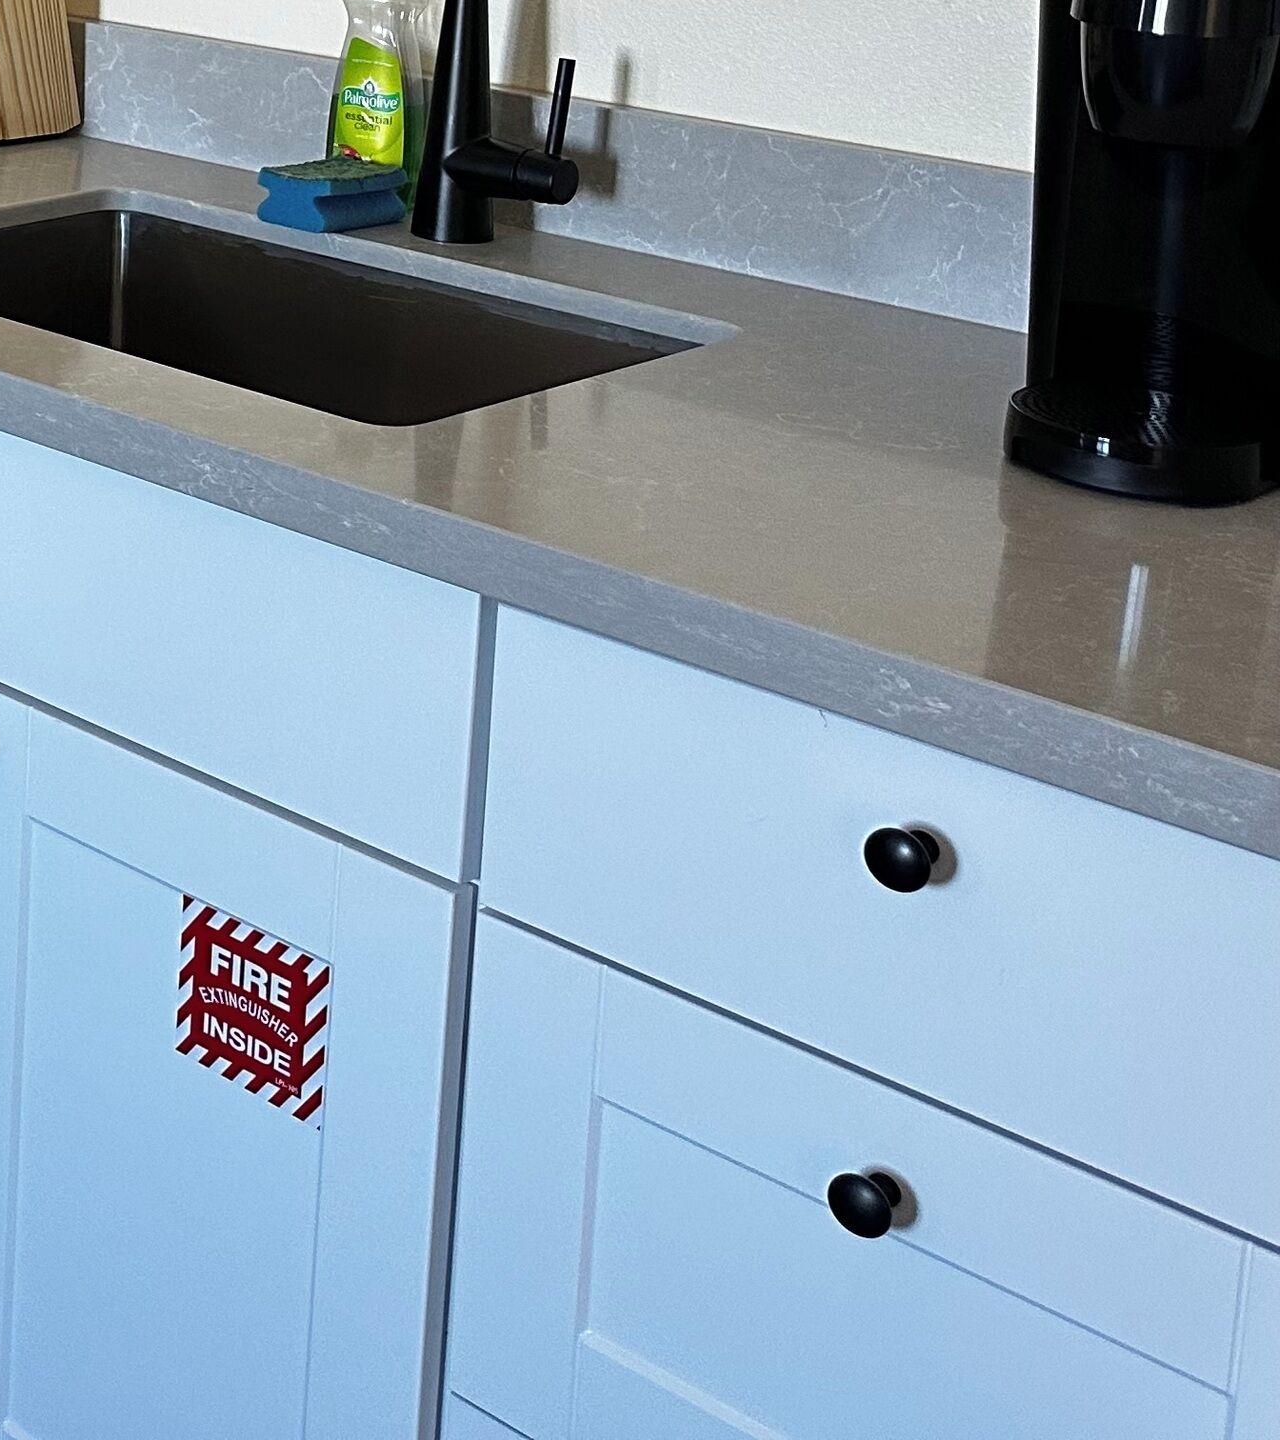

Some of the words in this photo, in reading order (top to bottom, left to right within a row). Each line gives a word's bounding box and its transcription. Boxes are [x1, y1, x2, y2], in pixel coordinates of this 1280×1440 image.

[344, 89, 398, 109] Palmolive
[210, 943, 292, 1012] FIRE
[198, 986, 299, 1047] EXTINGUISHER
[203, 1012, 292, 1077] INSIDE
